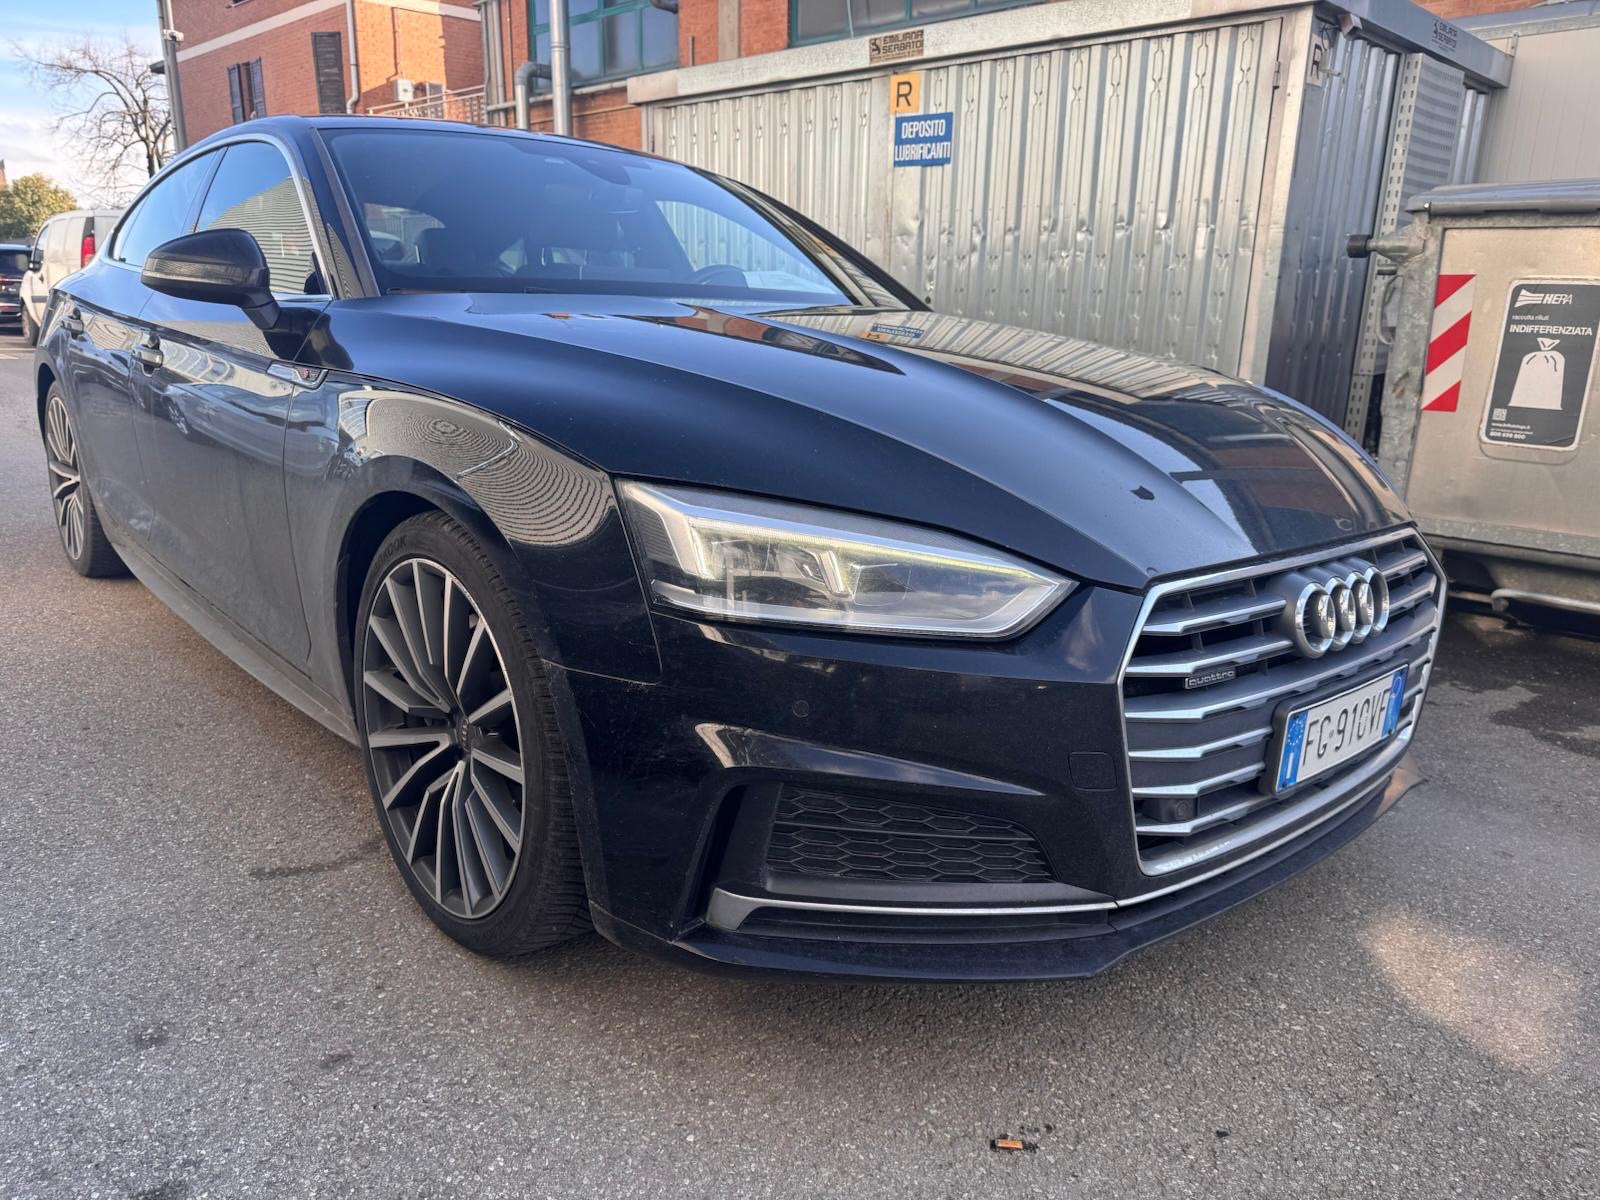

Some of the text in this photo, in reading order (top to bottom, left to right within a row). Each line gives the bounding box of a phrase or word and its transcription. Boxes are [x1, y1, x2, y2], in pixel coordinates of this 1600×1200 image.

[883, 29, 924, 44] EMILIANA
[882, 39, 924, 54] SERBATOI
[1311, 43, 1323, 80] R
[896, 81, 912, 107] R
[902, 119, 946, 139] DEPOSITO
[895, 142, 951, 161] LUBRIFICANTI
[1541, 293, 1573, 305] HERA
[1509, 324, 1593, 336] INDIFFERENZIATA
[1189, 671, 1235, 688] quattro
